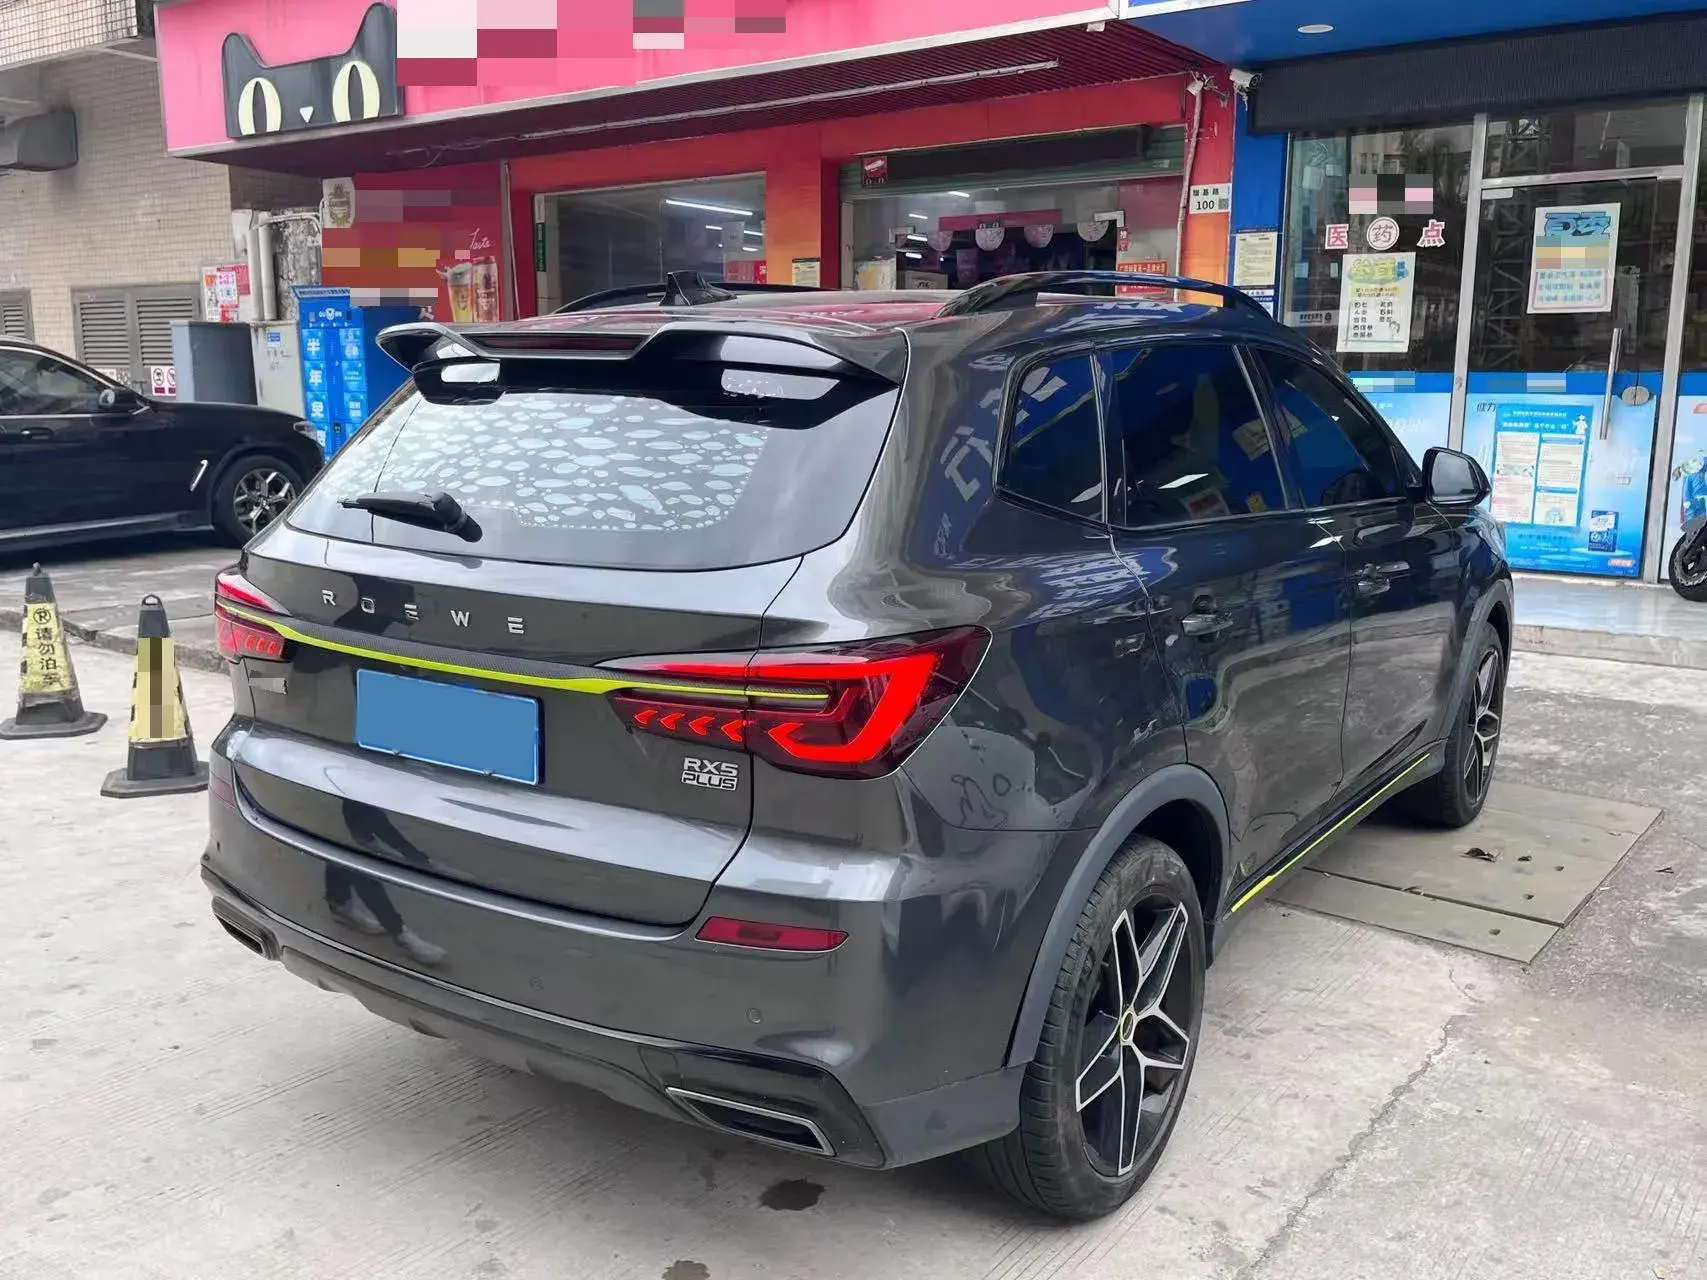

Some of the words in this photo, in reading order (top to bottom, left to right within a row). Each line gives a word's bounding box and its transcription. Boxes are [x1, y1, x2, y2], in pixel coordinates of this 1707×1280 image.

[1196, 200, 1215, 210] 100
[321, 589, 525, 634] ROEWE
[683, 757, 738, 777] RX5
[681, 770, 738, 791] PLUS
